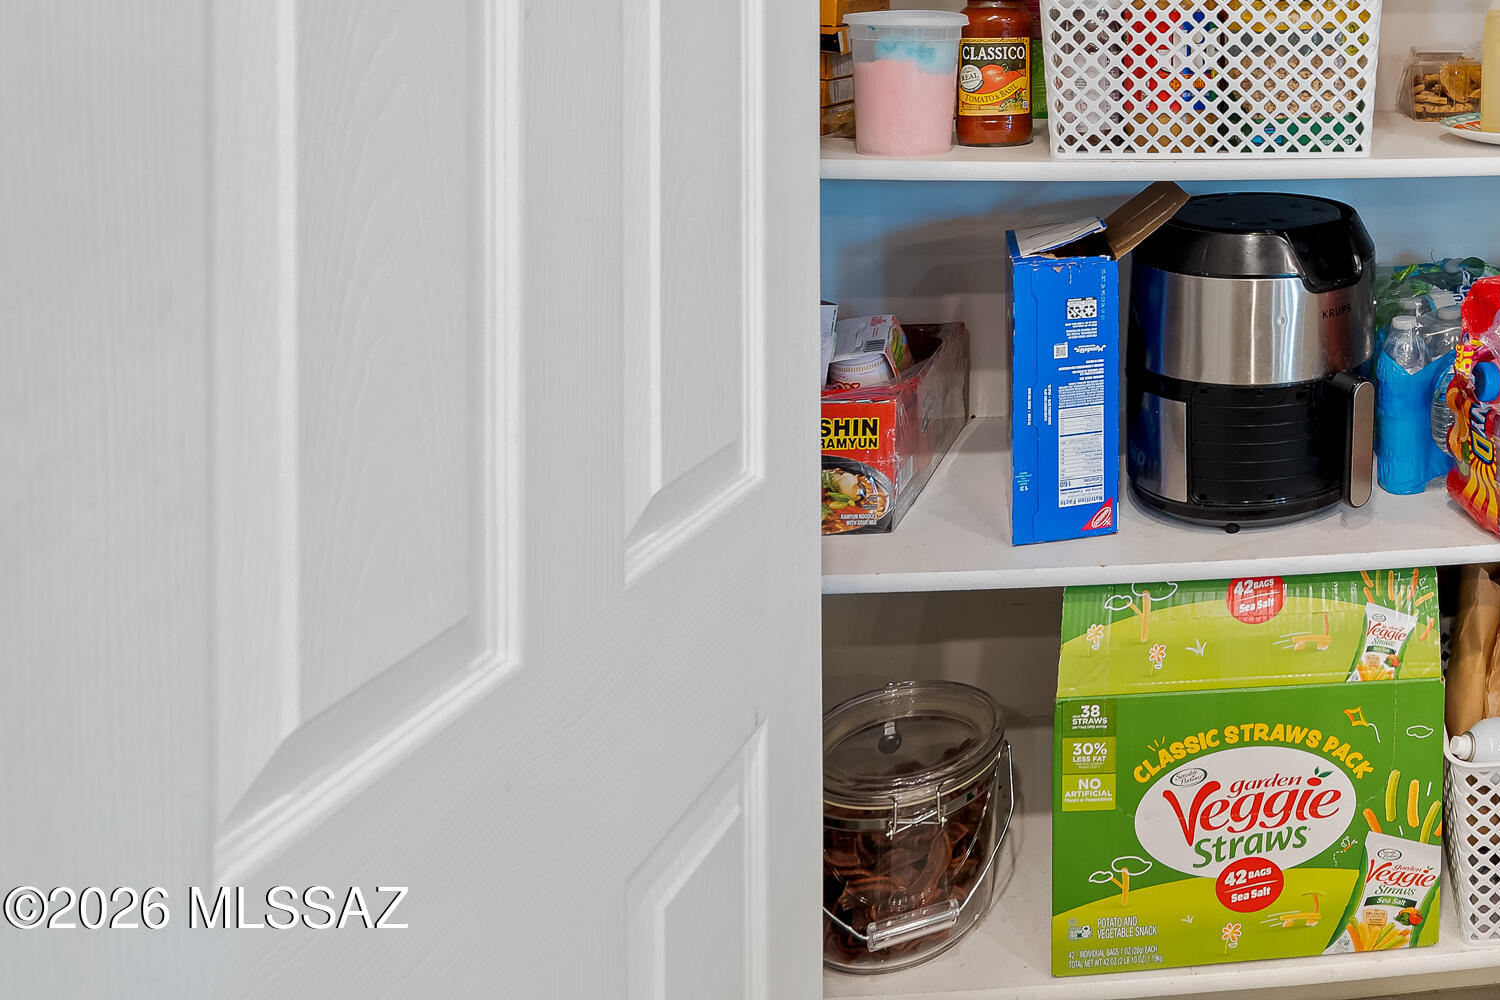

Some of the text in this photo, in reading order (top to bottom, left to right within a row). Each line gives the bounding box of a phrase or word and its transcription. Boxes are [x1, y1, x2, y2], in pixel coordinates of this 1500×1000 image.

[962, 46, 1025, 60] CLASSICO
[965, 93, 994, 103] TOMATO
[1000, 83, 1019, 97] BASIL
[1322, 304, 1352, 319] KRUPS
[820, 418, 878, 438] SHIN
[1233, 579, 1275, 596] 42 BAGS
[1239, 598, 1275, 613] Sea Salt
[1366, 620, 1407, 642] Veggie
[1080, 704, 1101, 718] 38
[1072, 717, 1108, 726] STRAWS
[1072, 742, 1108, 756] 30%
[1133, 723, 1374, 783] CLASSIC STRAWS PACK
[1078, 778, 1101, 790] NO
[1227, 773, 1302, 799] garden
[1064, 790, 1113, 798] ARTIFICIAL
[1162, 778, 1342, 847] Veggie
[1192, 825, 1308, 869] Straws
[1224, 867, 1272, 887] 42 BAGS
[1365, 859, 1437, 888] Veggie
[1230, 886, 1271, 903] Sea Salt
[1374, 884, 1416, 896] Straws
[1376, 897, 1407, 906] Sea Salt
[1097, 916, 1138, 929] POTATO AND
[1097, 925, 1158, 940] VEGETABLE SNACK
[1106, 947, 1120, 957] BAGS
[1144, 945, 1158, 954] EACH
